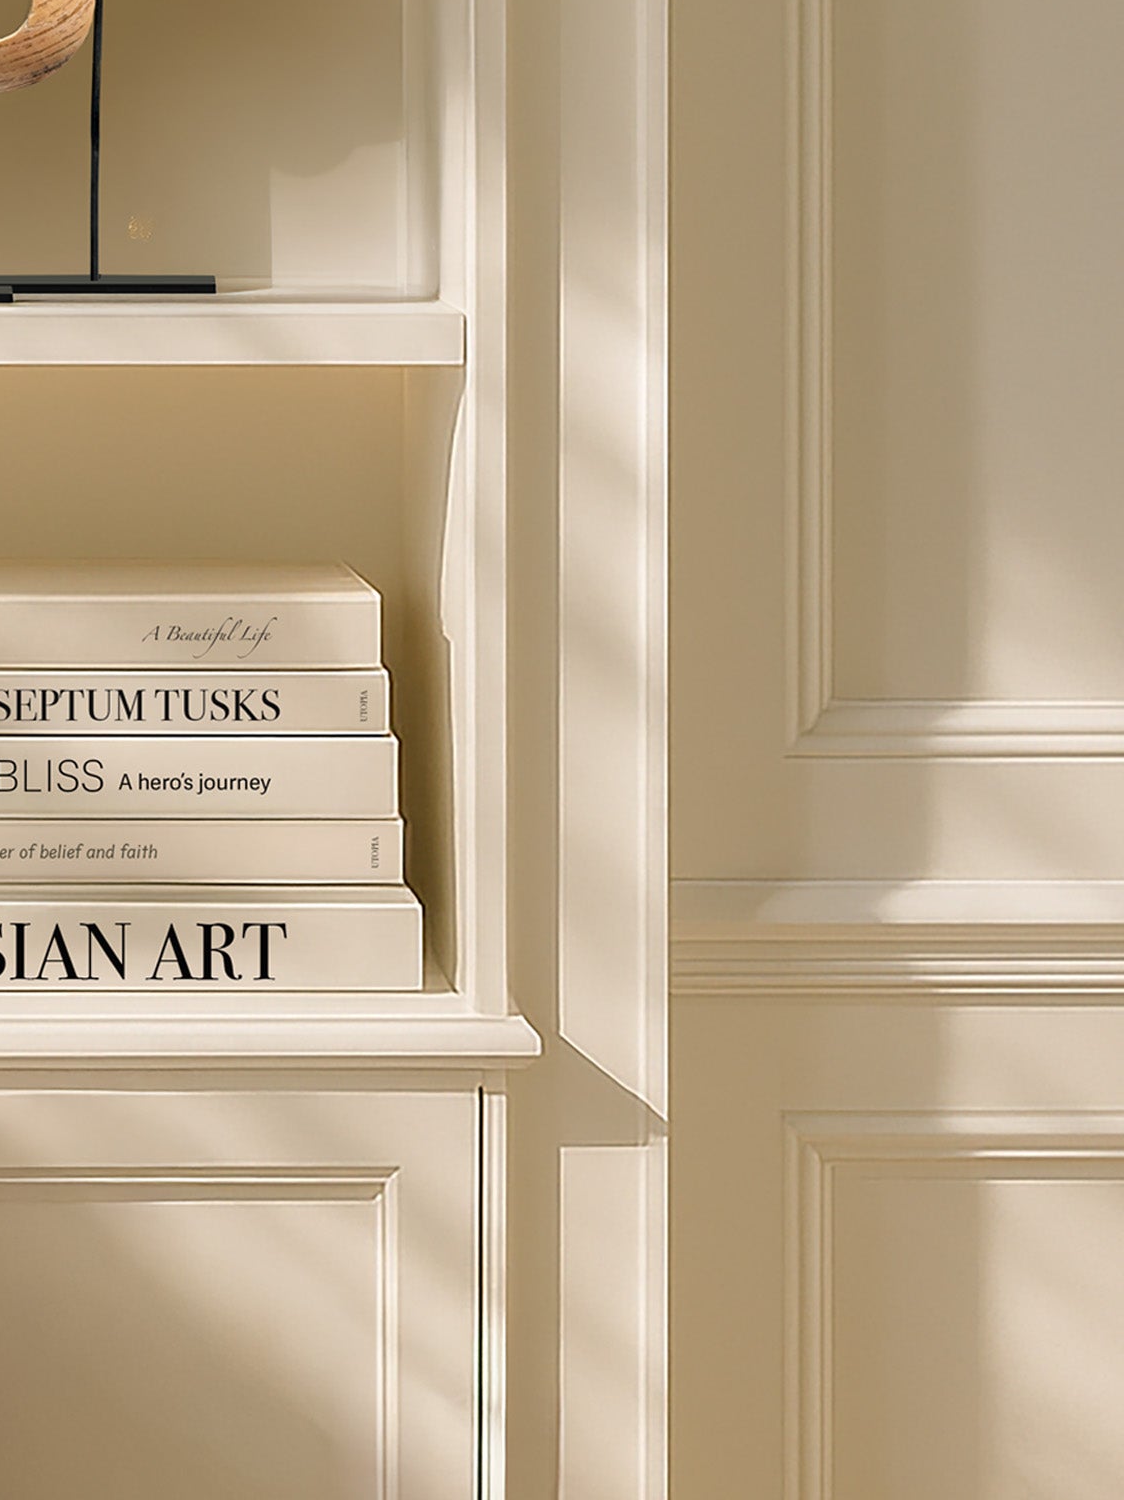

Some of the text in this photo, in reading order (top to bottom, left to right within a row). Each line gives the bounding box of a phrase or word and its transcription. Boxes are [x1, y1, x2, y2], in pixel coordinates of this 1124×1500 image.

[142, 617, 278, 659] A Beautiful Life
[155, 688, 281, 722] TUSKS
[360, 690, 368, 723] UTOPIA
[119, 773, 133, 790] A
[196, 773, 272, 795] journey
[19, 843, 37, 859] of
[39, 843, 84, 859] belief
[86, 844, 115, 859] and
[120, 843, 158, 859] faith
[371, 836, 380, 869] UTOPIA
[145, 922, 288, 981] ART
